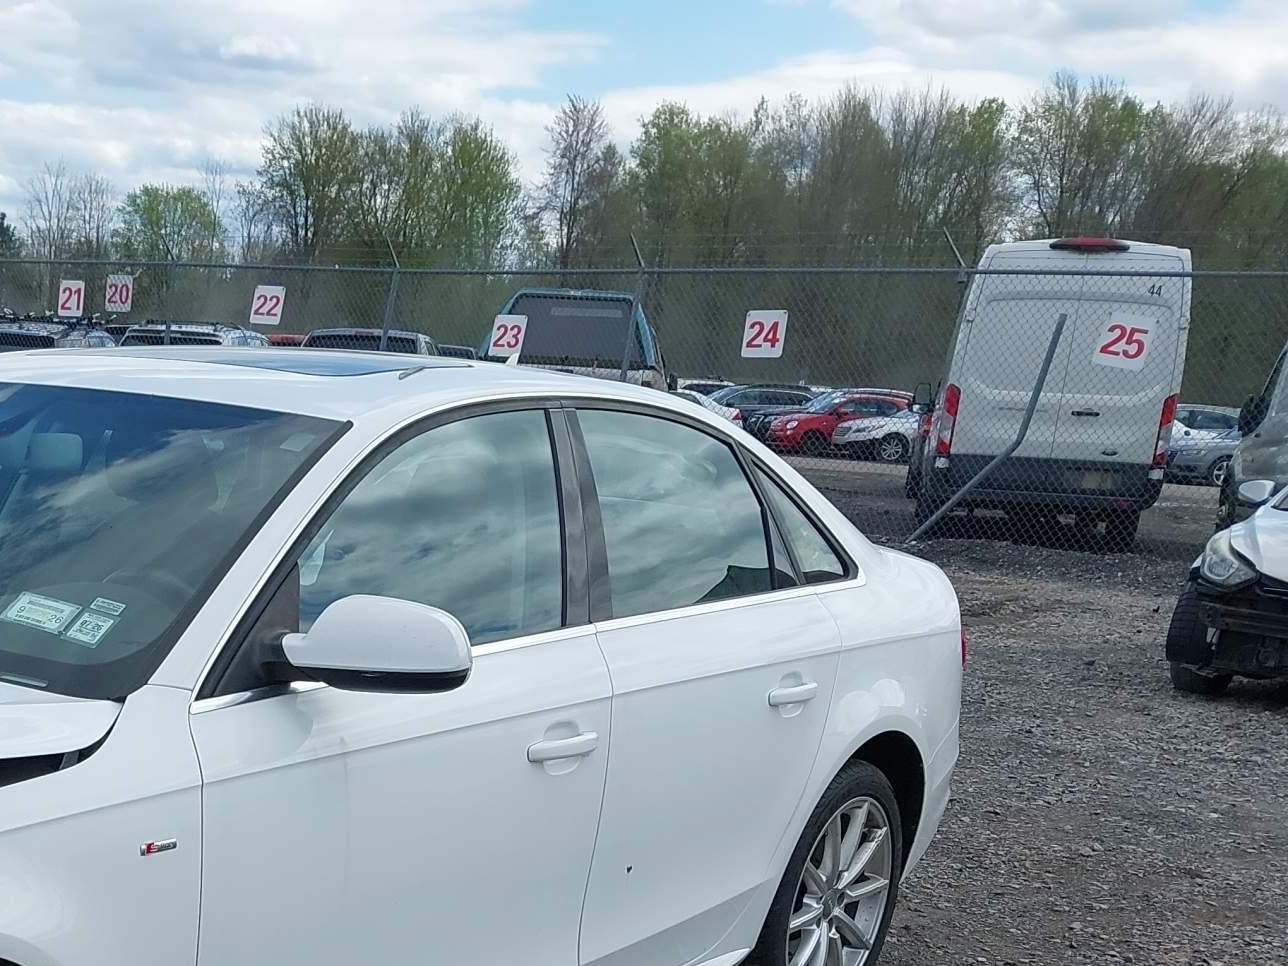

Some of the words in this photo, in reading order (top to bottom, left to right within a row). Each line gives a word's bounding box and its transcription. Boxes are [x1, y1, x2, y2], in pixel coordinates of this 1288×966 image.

[61, 287, 82, 311] 21
[107, 283, 130, 305] 20
[1147, 283, 1163, 297] 44
[253, 294, 281, 317] 22
[492, 323, 522, 349] 23
[745, 320, 780, 348] 24
[1099, 324, 1149, 360] 25
[47, 614, 64, 624] 26
